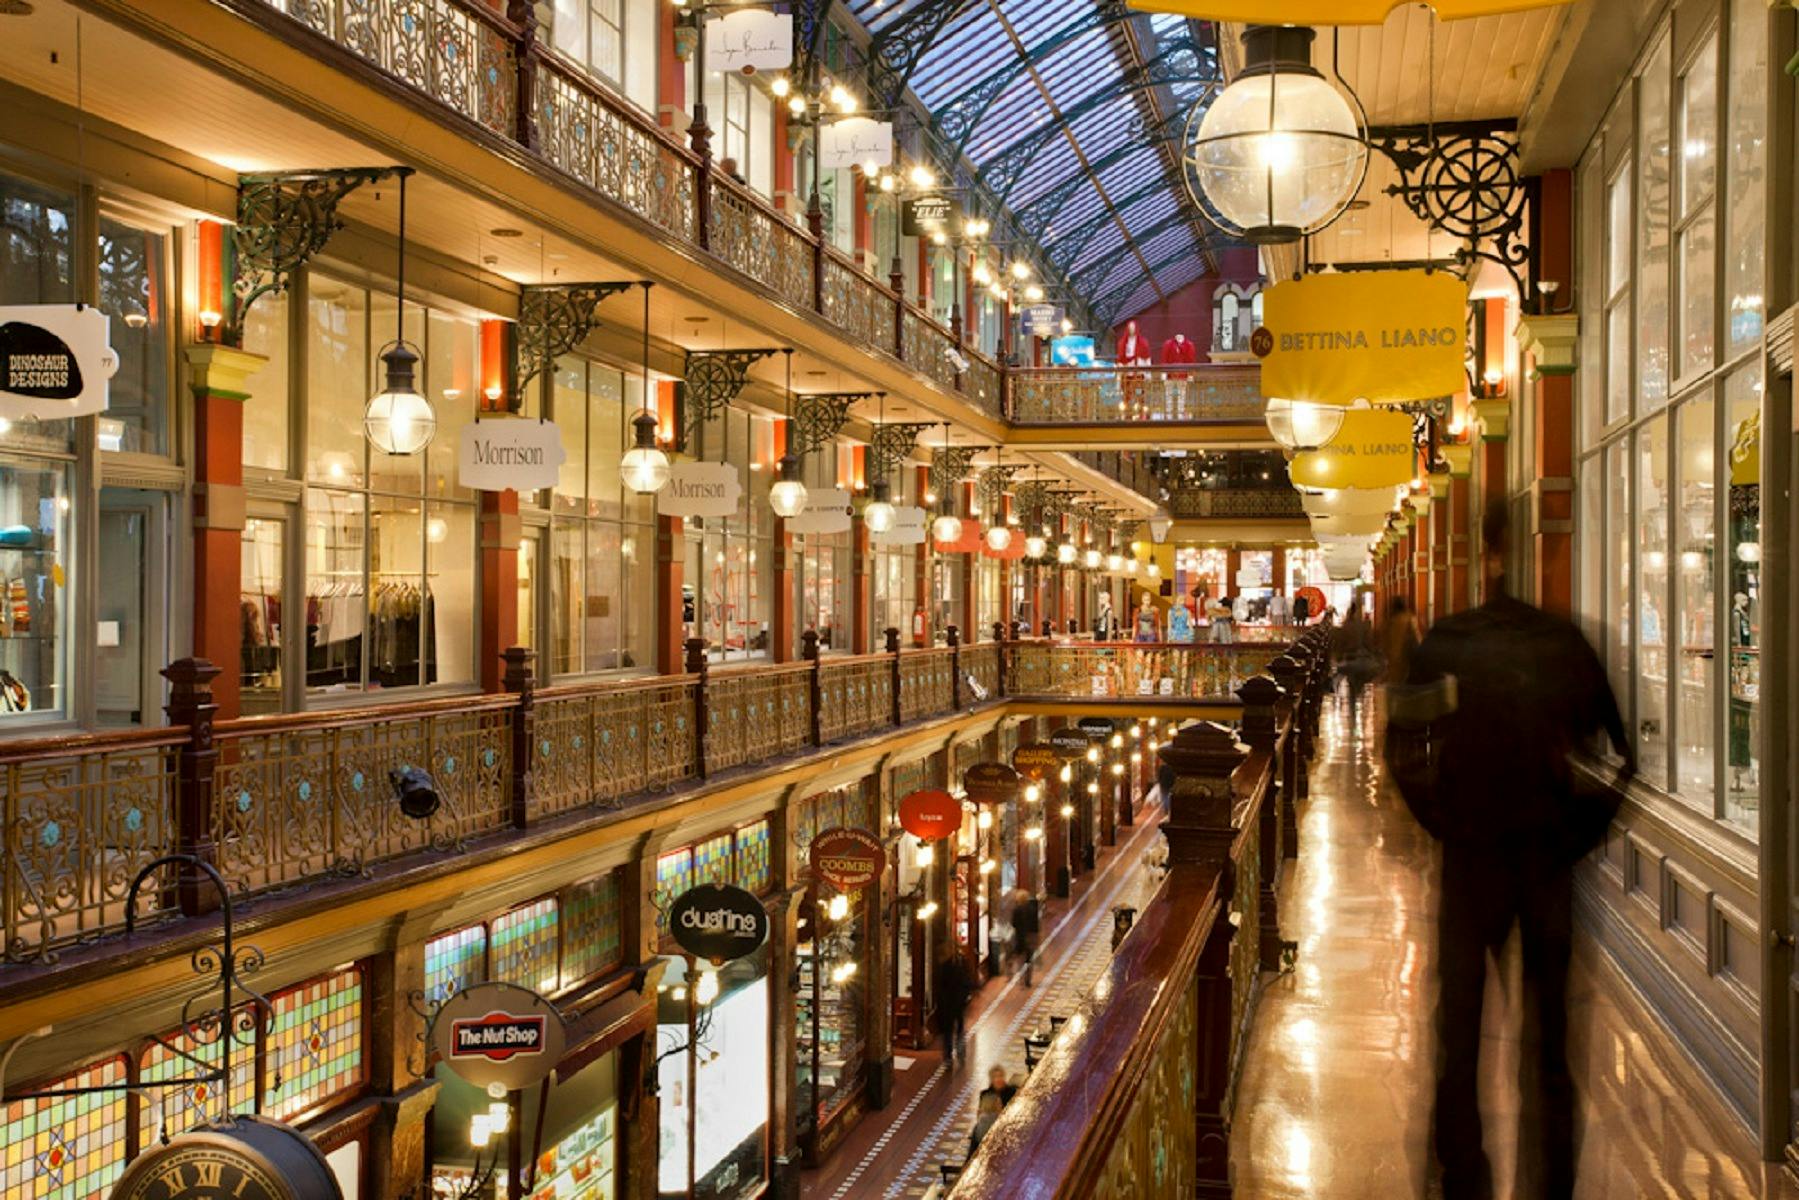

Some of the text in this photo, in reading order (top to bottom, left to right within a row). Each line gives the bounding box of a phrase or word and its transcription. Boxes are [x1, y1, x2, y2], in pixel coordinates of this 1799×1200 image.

[1253, 326, 1458, 352] 76 BETTINA LIANO
[8, 353, 69, 371] DINOSAUR
[101, 357, 113, 368] 77
[8, 371, 69, 388] DESIGNS
[472, 438, 544, 465] Morrison
[1362, 443, 1408, 456] LIANO
[668, 478, 726, 498] Morrison
[458, 1025, 538, 1046] The Nut Shop
[158, 1165, 188, 1199] XI
[191, 1160, 226, 1188] XII
